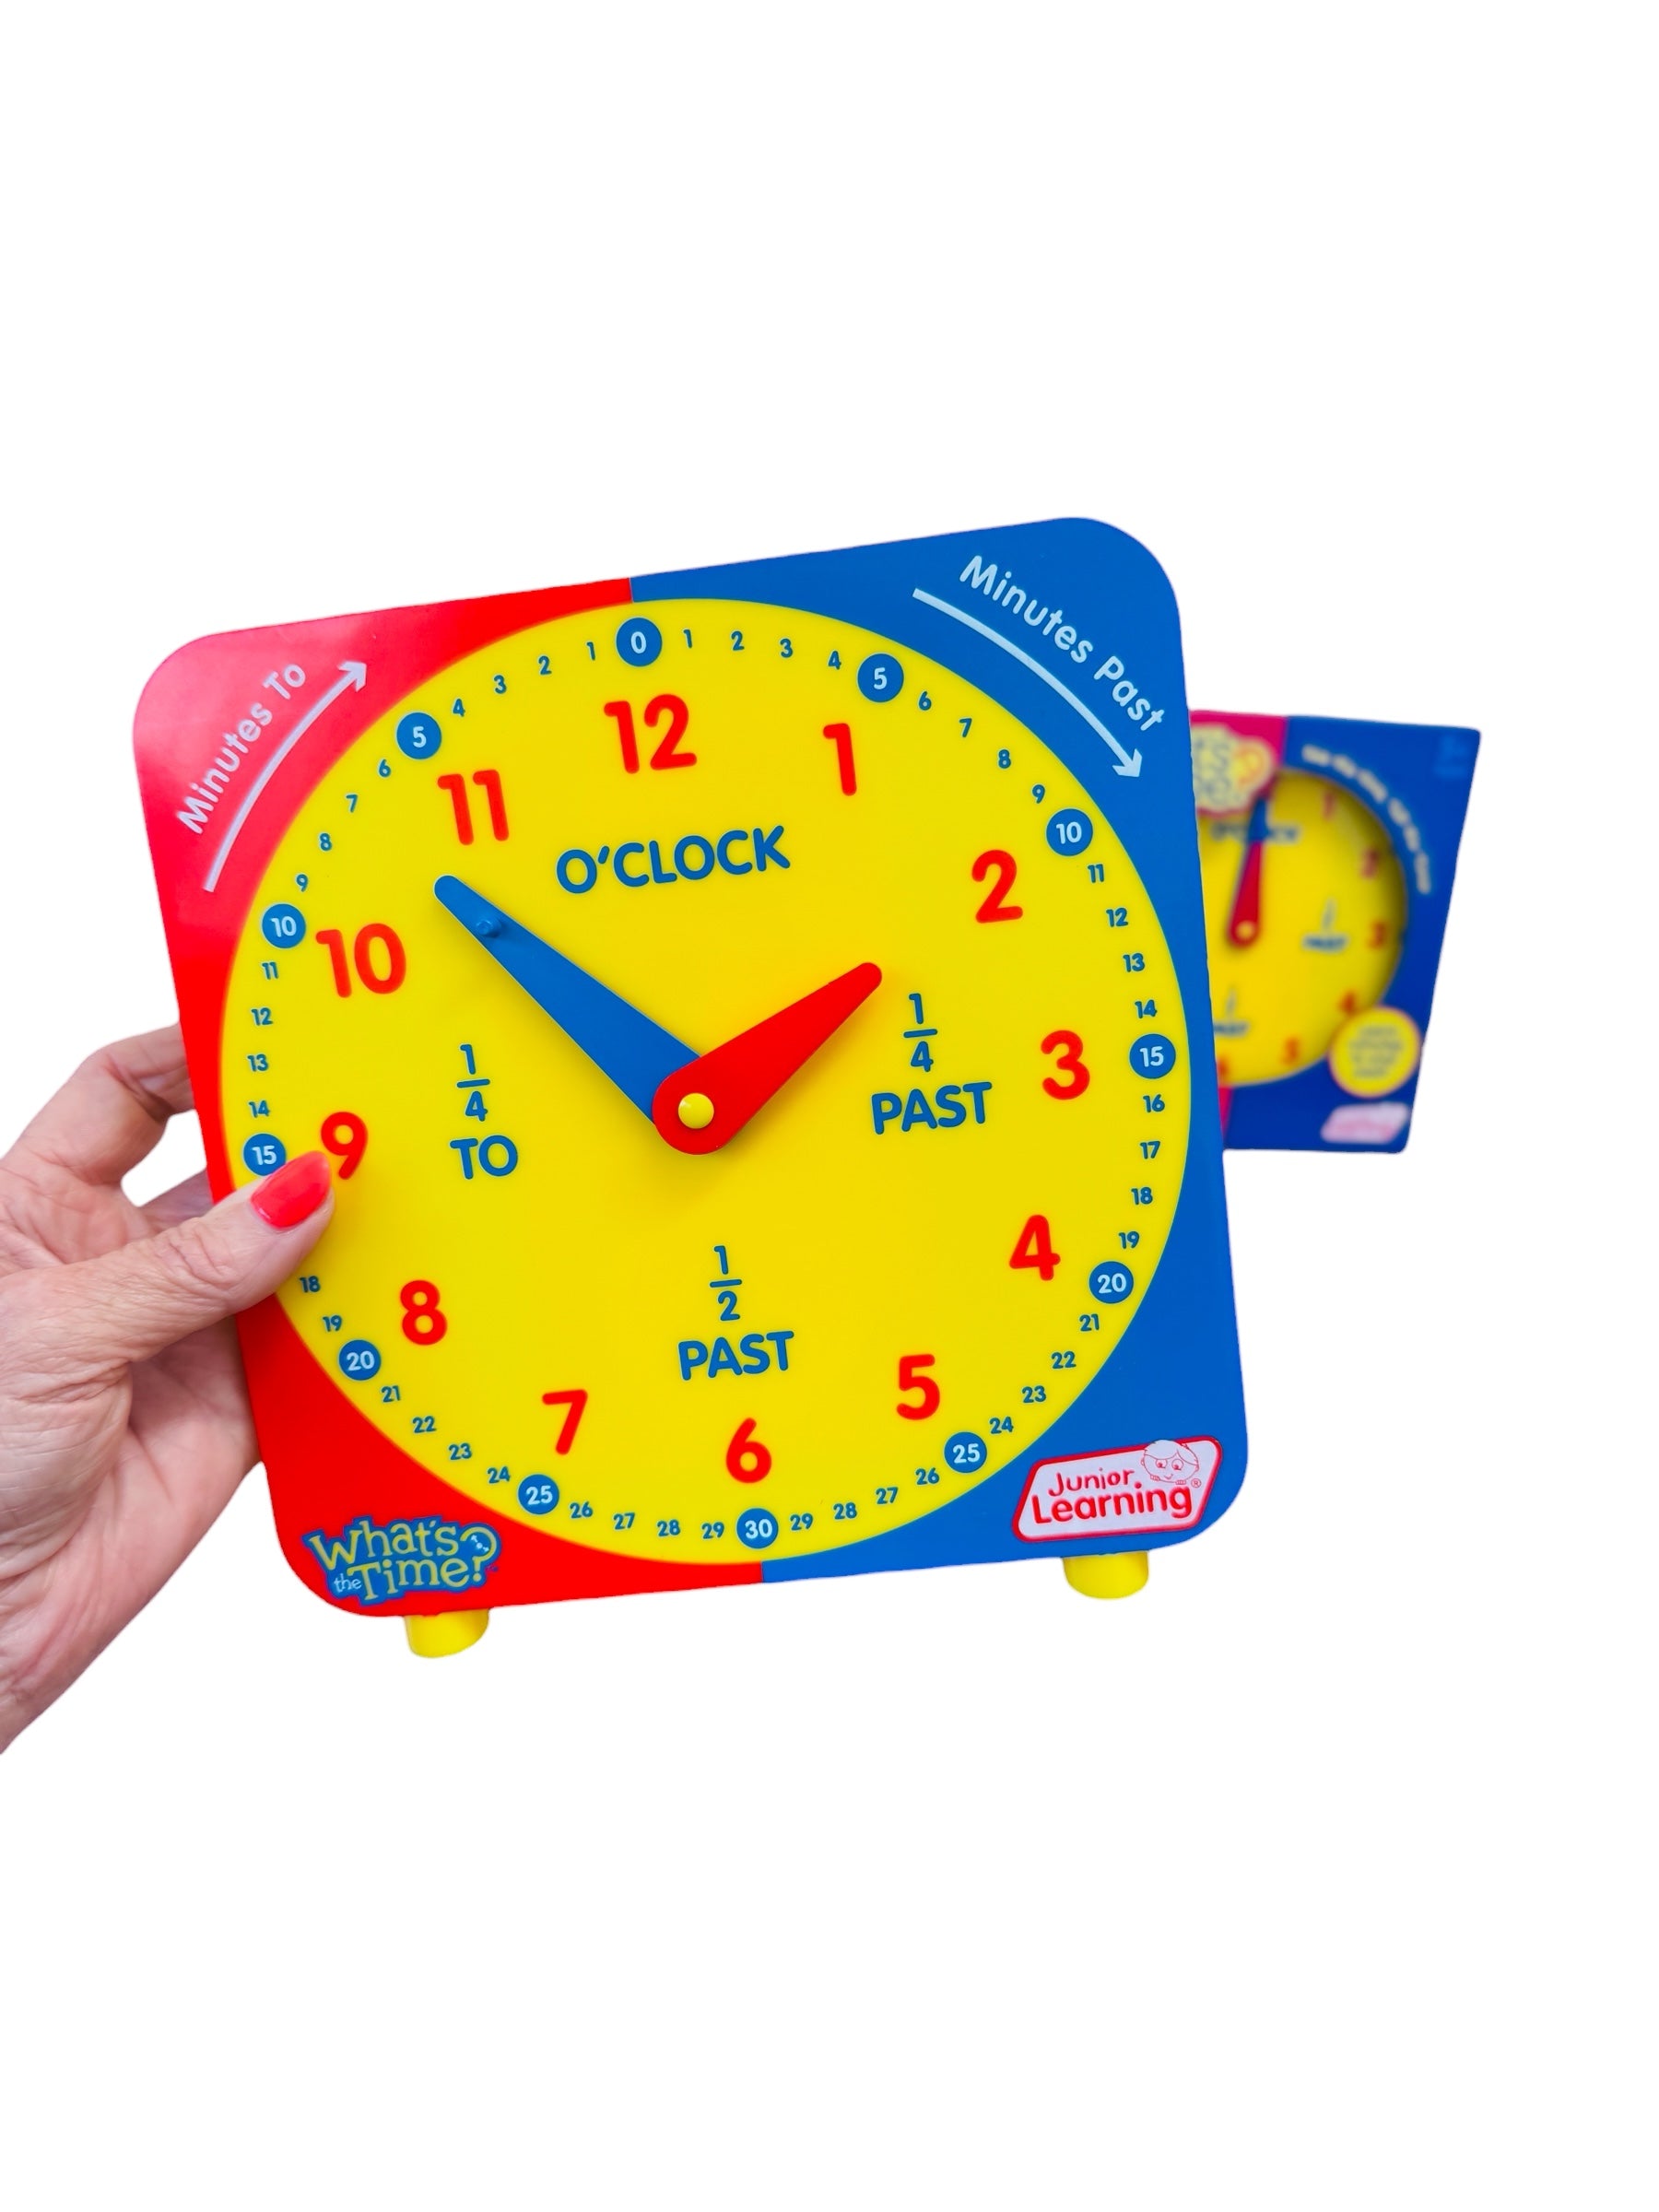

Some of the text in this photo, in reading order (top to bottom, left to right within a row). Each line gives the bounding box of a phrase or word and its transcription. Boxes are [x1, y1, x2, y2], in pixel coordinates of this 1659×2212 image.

[630, 631, 647, 654] 0
[683, 629, 693, 649] 1
[731, 630, 745, 651] 2
[780, 638, 794, 658] 3
[959, 555, 1165, 731] Minutes Past
[586, 641, 595, 661] 1
[828, 650, 842, 670] 4
[538, 655, 552, 676] 2
[493, 675, 507, 694] 3
[874, 667, 888, 690] 5
[453, 698, 465, 717] 4
[918, 690, 932, 712] 6
[413, 725, 427, 748] 5
[603, 693, 698, 775] 12
[959, 717, 972, 738] 7
[177, 664, 306, 834] Minutes To
[998, 748, 1012, 770] 8
[379, 759, 391, 778] 6
[822, 722, 858, 797] 1
[346, 794, 358, 813] 7
[1031, 784, 1046, 804] 9
[436, 769, 510, 846] 11
[319, 832, 332, 852] 8
[1055, 821, 1082, 844] 10
[556, 825, 791, 894] O'CLOCK
[296, 874, 308, 892] 9
[1087, 864, 1105, 884] 11
[971, 849, 1024, 924] 2
[271, 915, 297, 937] 10
[1105, 907, 1129, 927] 12
[262, 961, 278, 980] 11
[314, 923, 406, 998] 10
[1123, 952, 1146, 973] 13
[251, 1007, 273, 1026] 12
[1134, 999, 1158, 1019] 14
[247, 1053, 269, 1072] 13
[1040, 1029, 1091, 1101] 3
[1139, 1045, 1164, 1067] 15
[248, 1100, 270, 1118] 14
[871, 1081, 993, 1135] PAST
[1142, 1093, 1166, 1113] 16
[252, 1145, 276, 1166] 15
[319, 1111, 369, 1182] 9
[1139, 1140, 1161, 1159] 17
[449, 1135, 519, 1180] TO
[1131, 1186, 1154, 1206] 18
[1008, 1214, 1062, 1282] 4
[1118, 1230, 1140, 1250] 19
[299, 1275, 322, 1294] 18
[1097, 1273, 1127, 1294] 20
[398, 1278, 448, 1347] 8
[1079, 1313, 1100, 1332] 21
[322, 1314, 343, 1333] 19
[347, 1350, 375, 1371] 20
[677, 1330, 794, 1381] PAST
[1051, 1350, 1077, 1370] 22
[381, 1385, 401, 1403] 21
[896, 1353, 941, 1421] 5
[1021, 1385, 1047, 1404] 23
[412, 1415, 437, 1434] 22
[541, 1388, 589, 1456] 7
[989, 1416, 1014, 1435] 24
[448, 1442, 473, 1461] 23
[724, 1417, 772, 1485] 6
[952, 1442, 981, 1464] 25
[487, 1466, 511, 1484] 24
[915, 1467, 940, 1486] 26
[1048, 1466, 1135, 1498] Junior
[526, 1485, 553, 1505] 25
[876, 1487, 899, 1505] 27
[1030, 1480, 1193, 1524] Learning
[570, 1501, 594, 1519] 26
[833, 1502, 858, 1520] 28
[613, 1512, 636, 1530] 27
[657, 1519, 681, 1537] 28
[701, 1522, 724, 1539] 29
[745, 1518, 773, 1539] 30
[790, 1512, 814, 1531] 29
[308, 1520, 460, 1571] What's
[333, 1572, 363, 1594] the
